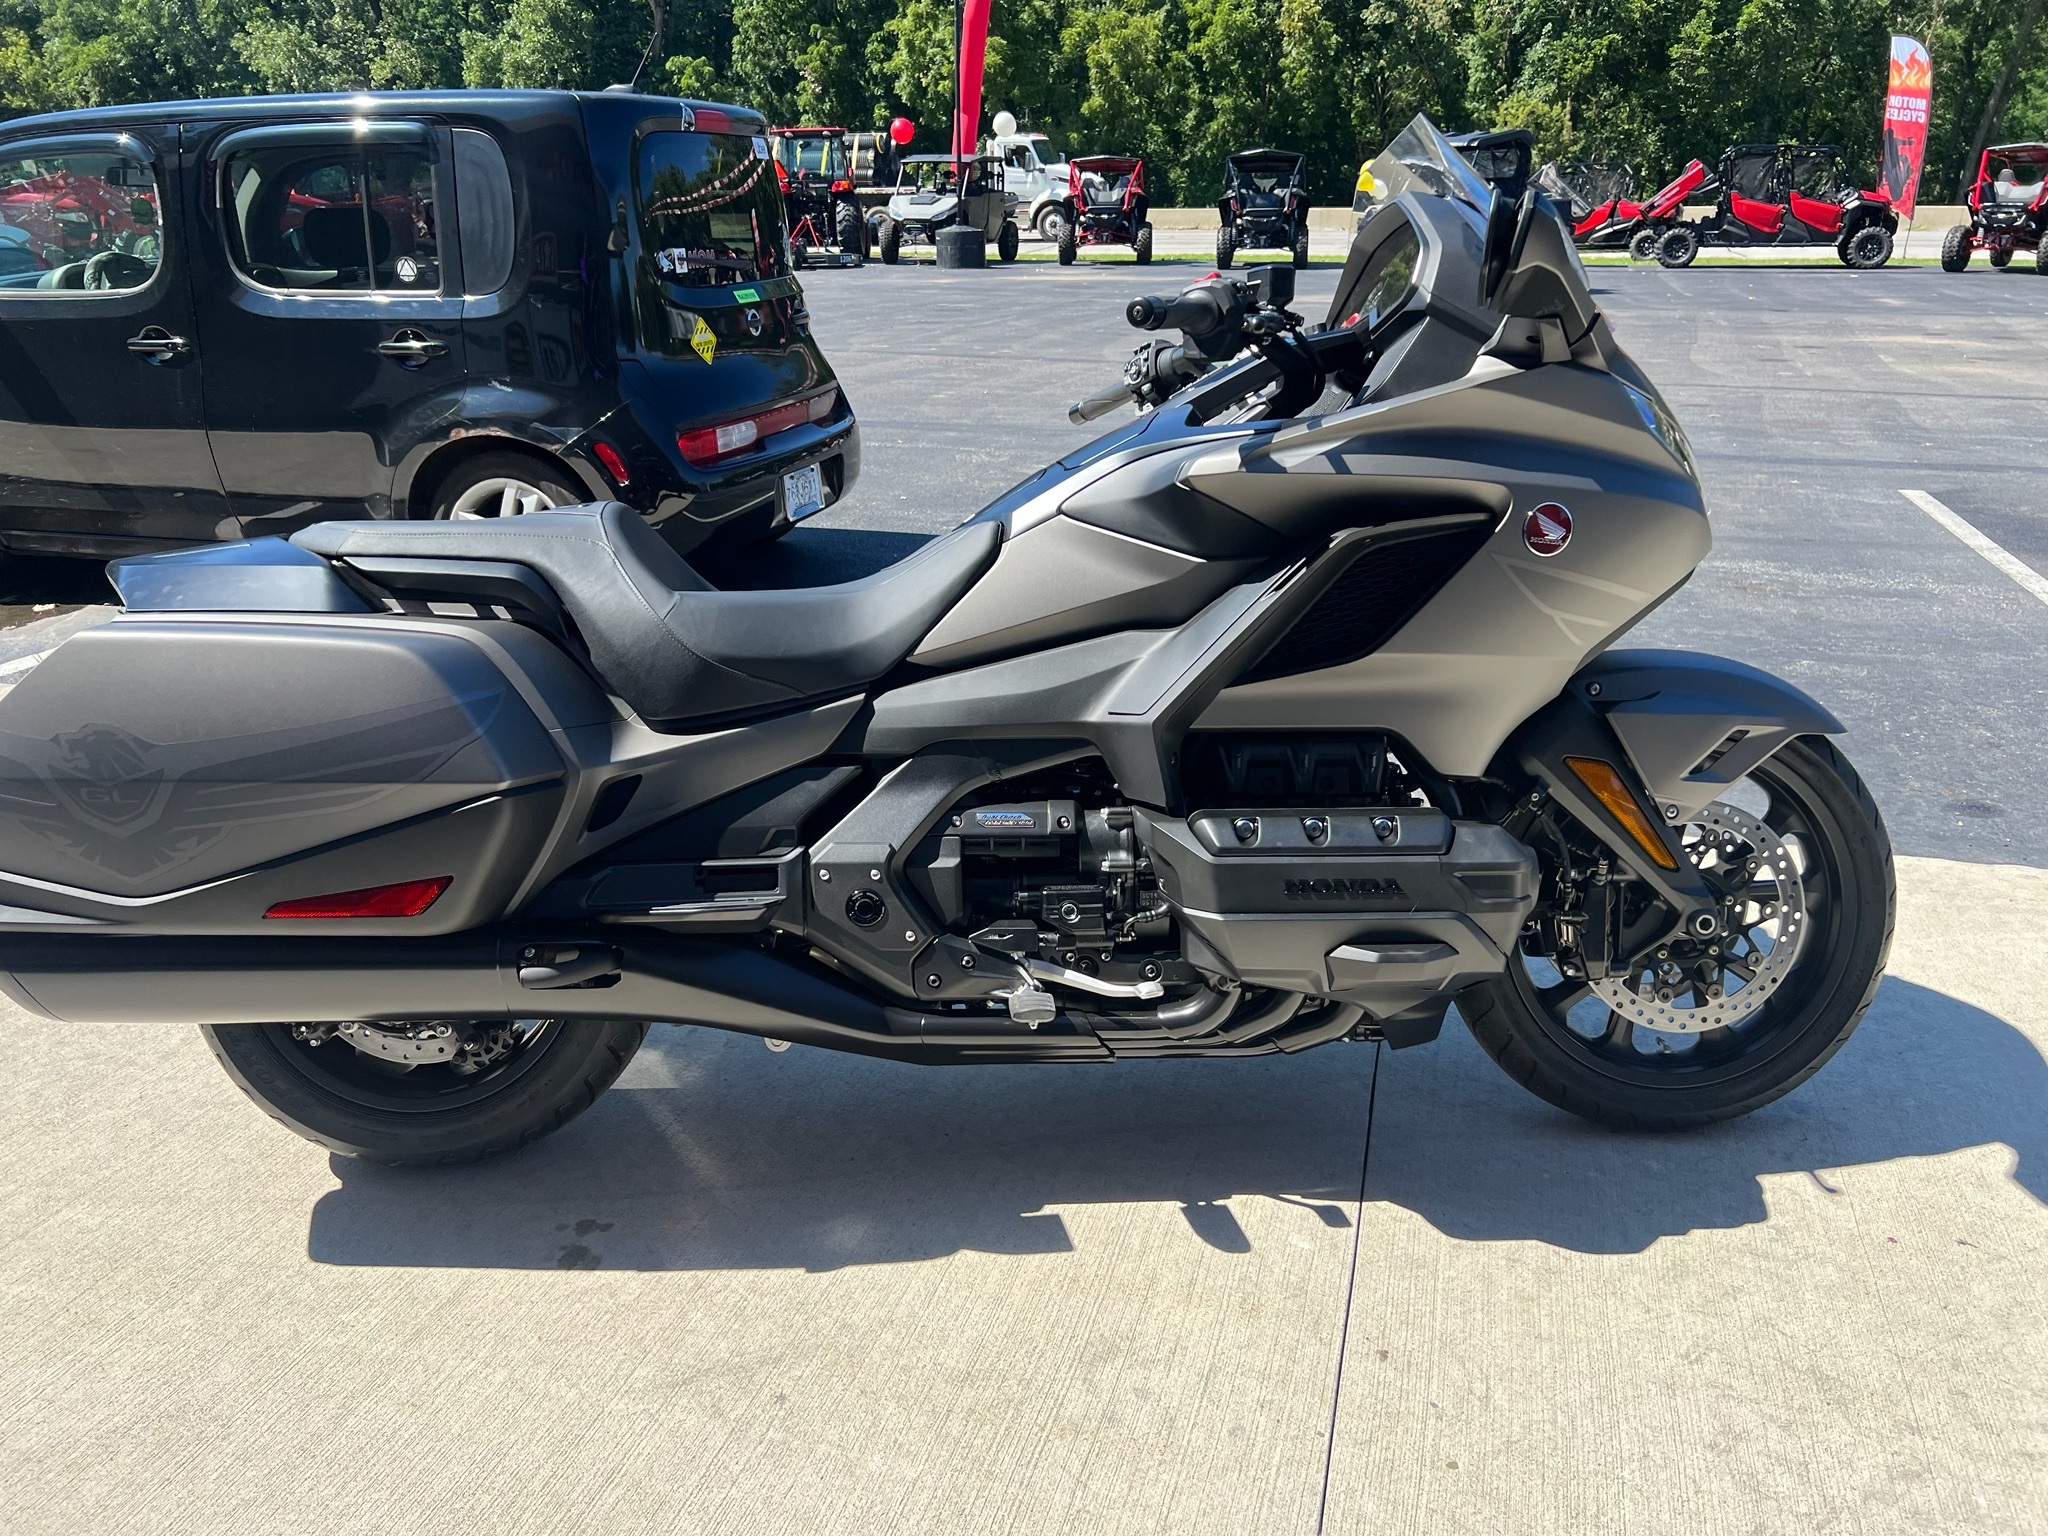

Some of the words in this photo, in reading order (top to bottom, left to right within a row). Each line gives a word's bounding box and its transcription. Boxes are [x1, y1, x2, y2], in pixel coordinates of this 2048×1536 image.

[1530, 536, 1564, 546] HONDA
[80, 787, 140, 803] GL
[1283, 878, 1407, 895] HONDA
